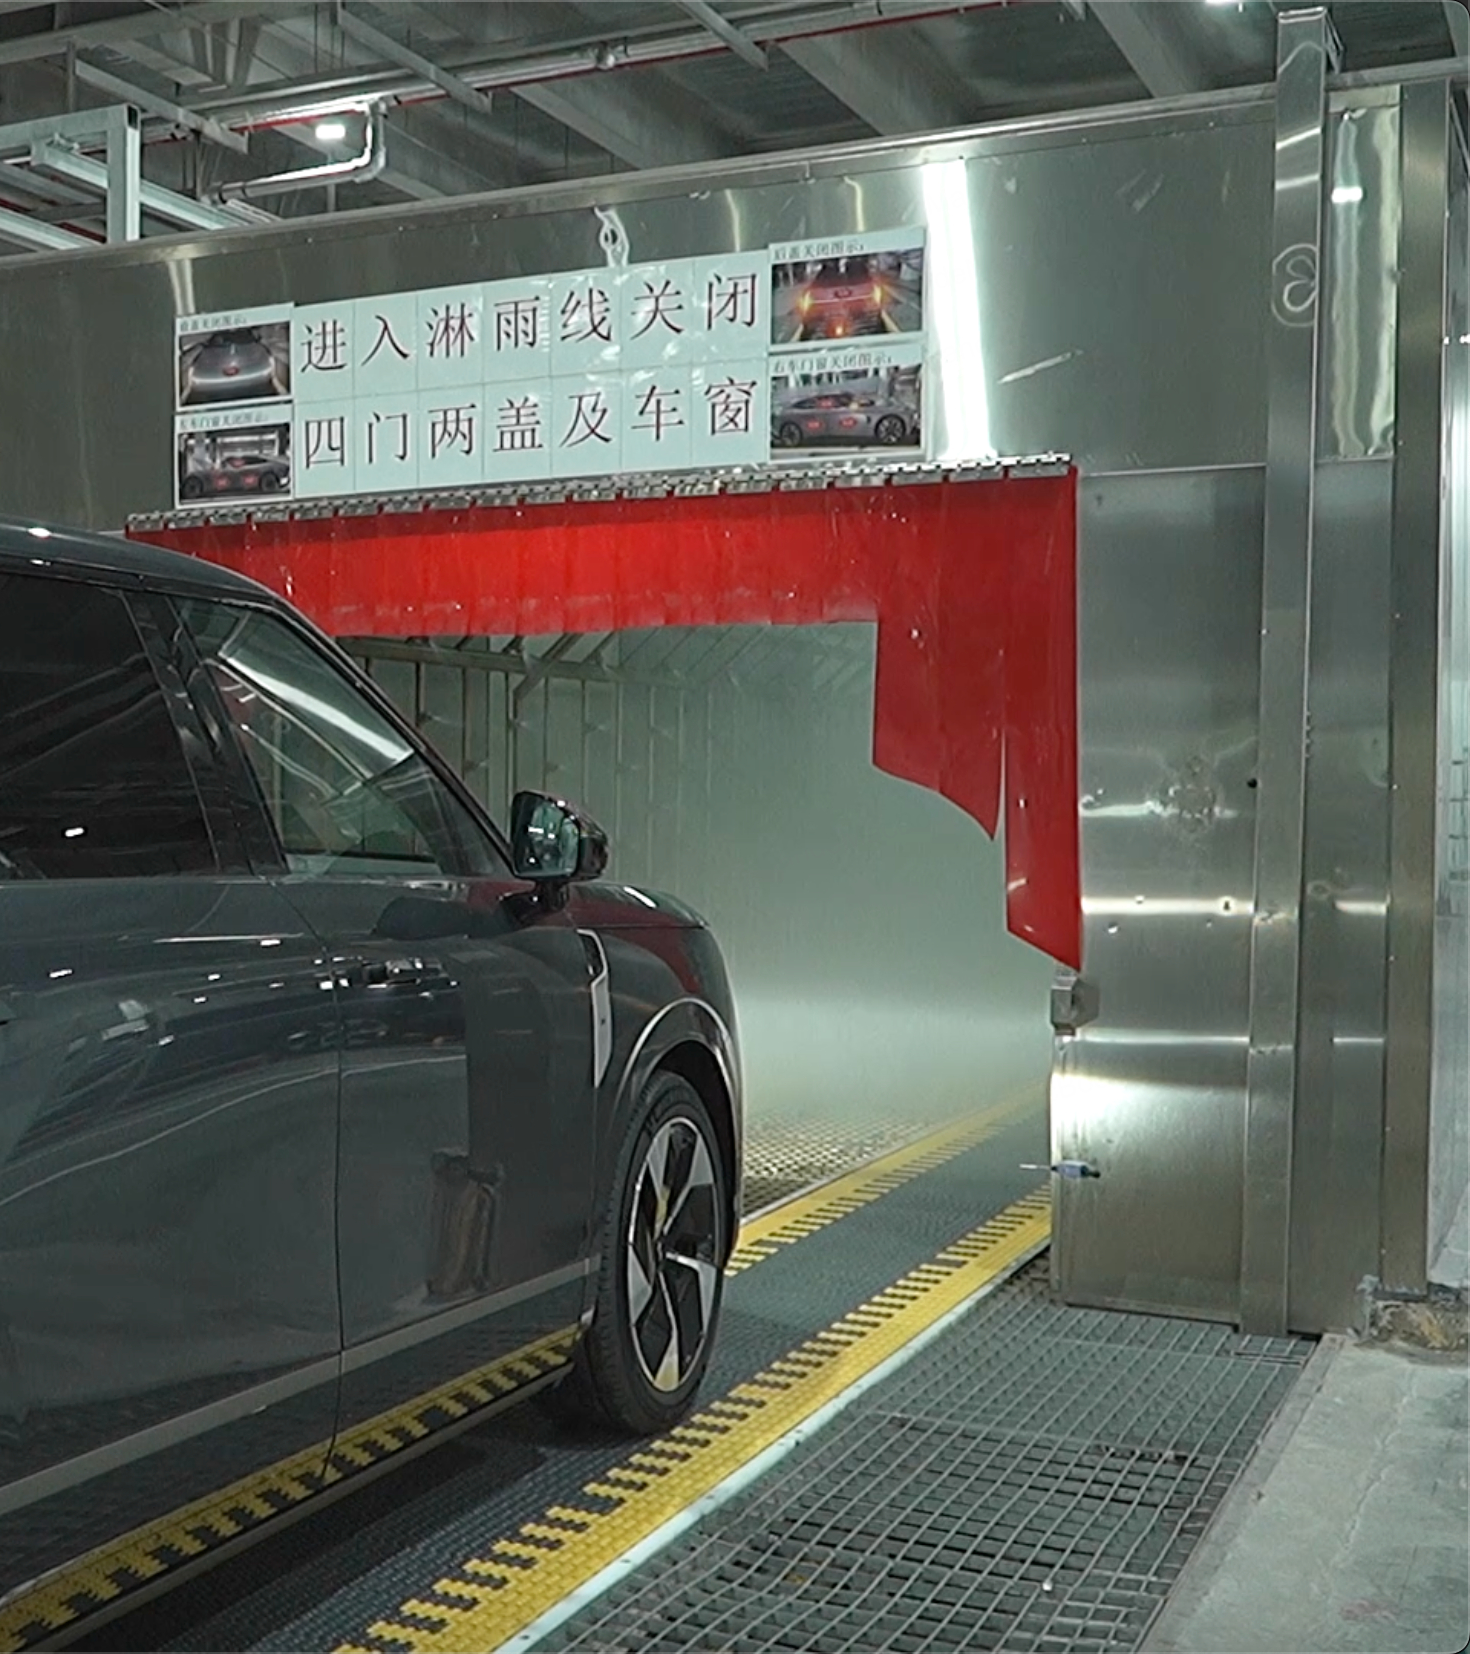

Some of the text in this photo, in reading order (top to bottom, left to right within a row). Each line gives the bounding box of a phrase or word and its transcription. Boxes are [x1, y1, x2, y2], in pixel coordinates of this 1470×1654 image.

[300, 273, 757, 373] 进入淋雨线关闭
[303, 377, 757, 470] 四门两盖及车窗
